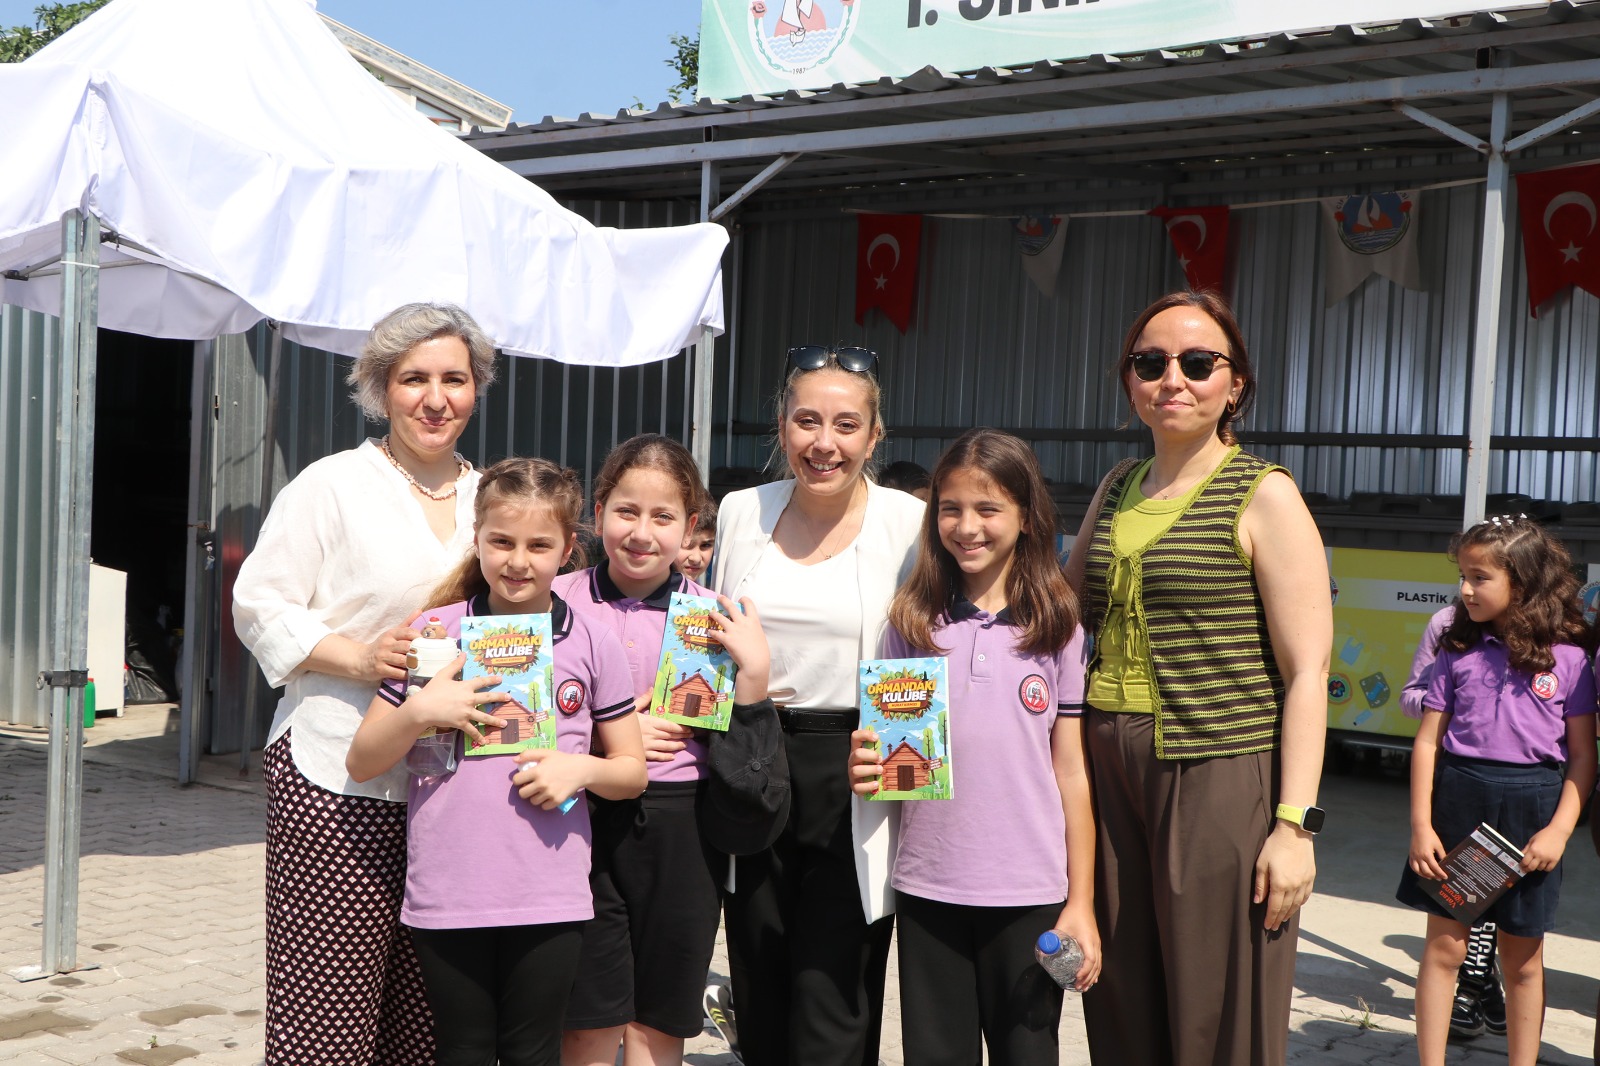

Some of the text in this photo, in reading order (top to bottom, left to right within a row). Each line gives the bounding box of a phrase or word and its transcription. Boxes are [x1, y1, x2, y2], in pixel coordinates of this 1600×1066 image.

[792, 67, 806, 75] 1987
[1397, 591, 1448, 604] PLASTİK
[485, 645, 533, 658] KULÜBE
[882, 689, 927, 703] KULÜBE
